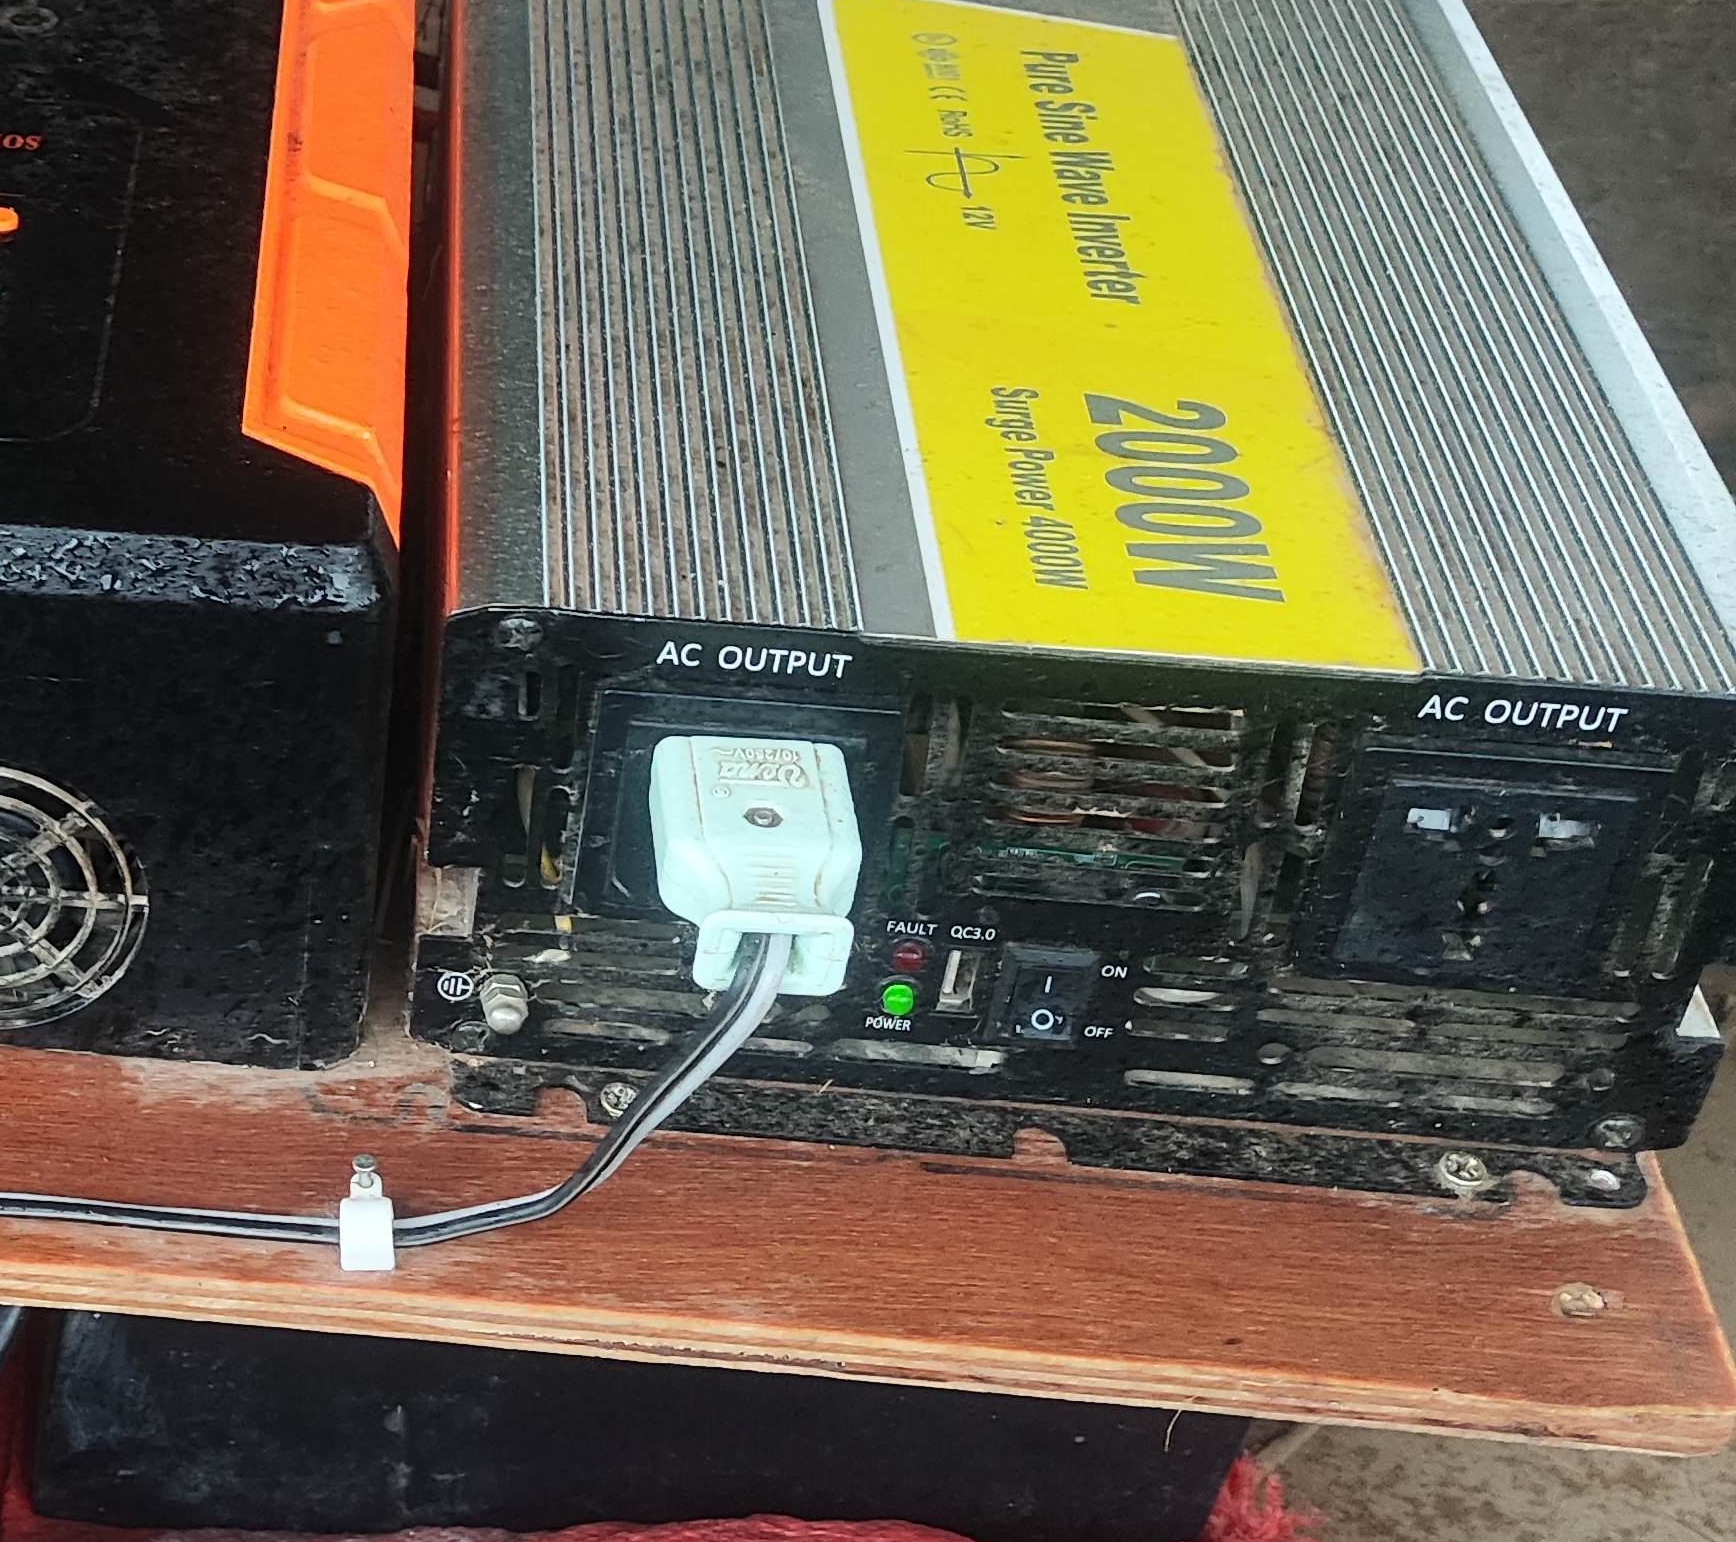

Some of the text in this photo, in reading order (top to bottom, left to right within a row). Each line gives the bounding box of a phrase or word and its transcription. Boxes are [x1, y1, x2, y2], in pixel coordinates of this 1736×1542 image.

[938, 109, 973, 137] RoHS
[962, 207, 995, 229] 12V
[1021, 49, 1143, 306] Pure Sine Wave Inverter
[984, 386, 1089, 590] Surge Power 4000W
[1078, 392, 1286, 603] 2000W
[657, 641, 852, 678] AC OUTPUT
[1418, 695, 1628, 732] AC OUTPUT
[887, 918, 937, 935] FAULT
[951, 926, 995, 940] QC3.0
[1102, 965, 1127, 978] ON
[866, 1016, 911, 1030] POWER
[1084, 1026, 1112, 1037] OFF
